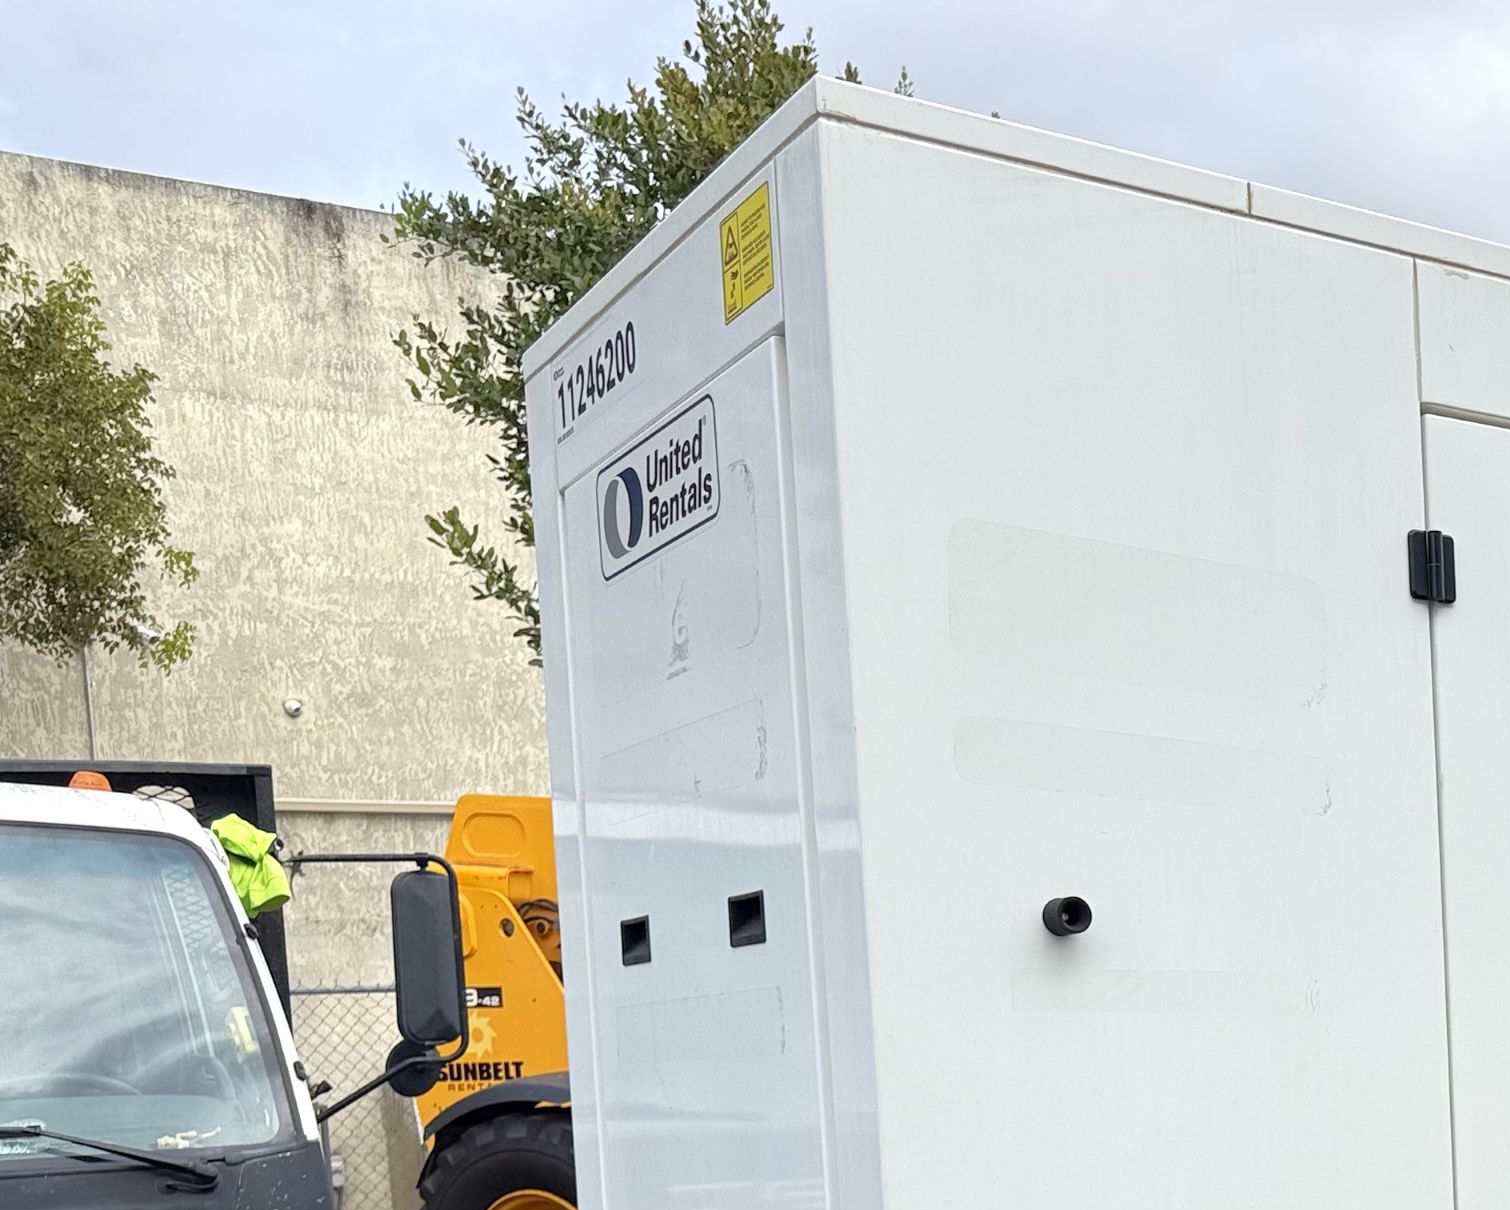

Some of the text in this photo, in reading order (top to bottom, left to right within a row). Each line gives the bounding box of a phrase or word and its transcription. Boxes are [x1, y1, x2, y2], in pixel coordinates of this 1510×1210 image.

[557, 320, 636, 430] 11246200
[646, 418, 702, 493] United
[649, 466, 712, 538] Rentals
[438, 1062, 524, 1082] SUNBELT
